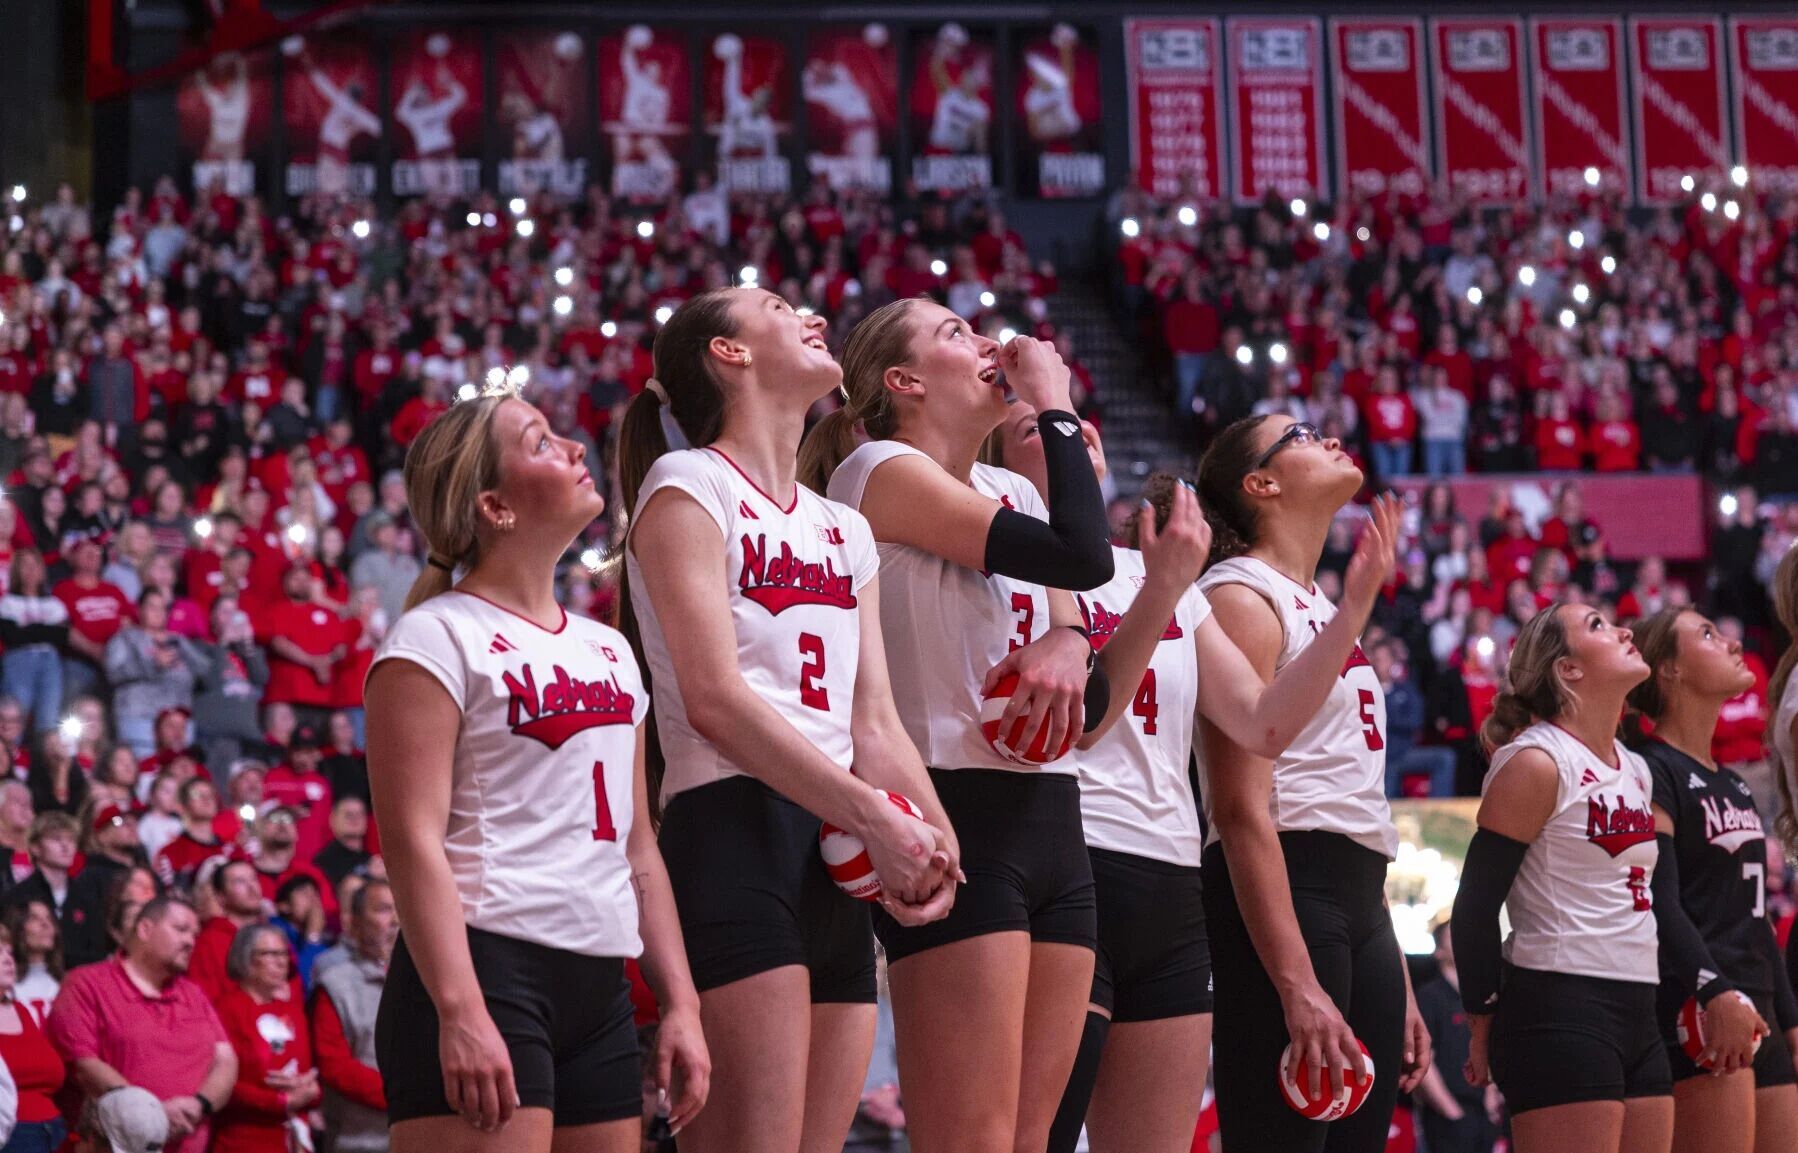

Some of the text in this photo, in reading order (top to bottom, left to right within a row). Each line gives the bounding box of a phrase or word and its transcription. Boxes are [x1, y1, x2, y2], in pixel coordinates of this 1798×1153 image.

[738, 533, 855, 602] Nebraska
[1008, 592, 1034, 654] 3
[798, 631, 831, 712] 2
[1132, 668, 1159, 736] 4
[1357, 688, 1384, 752] 5
[591, 760, 617, 843] 1
[1742, 862, 1765, 918] 7
